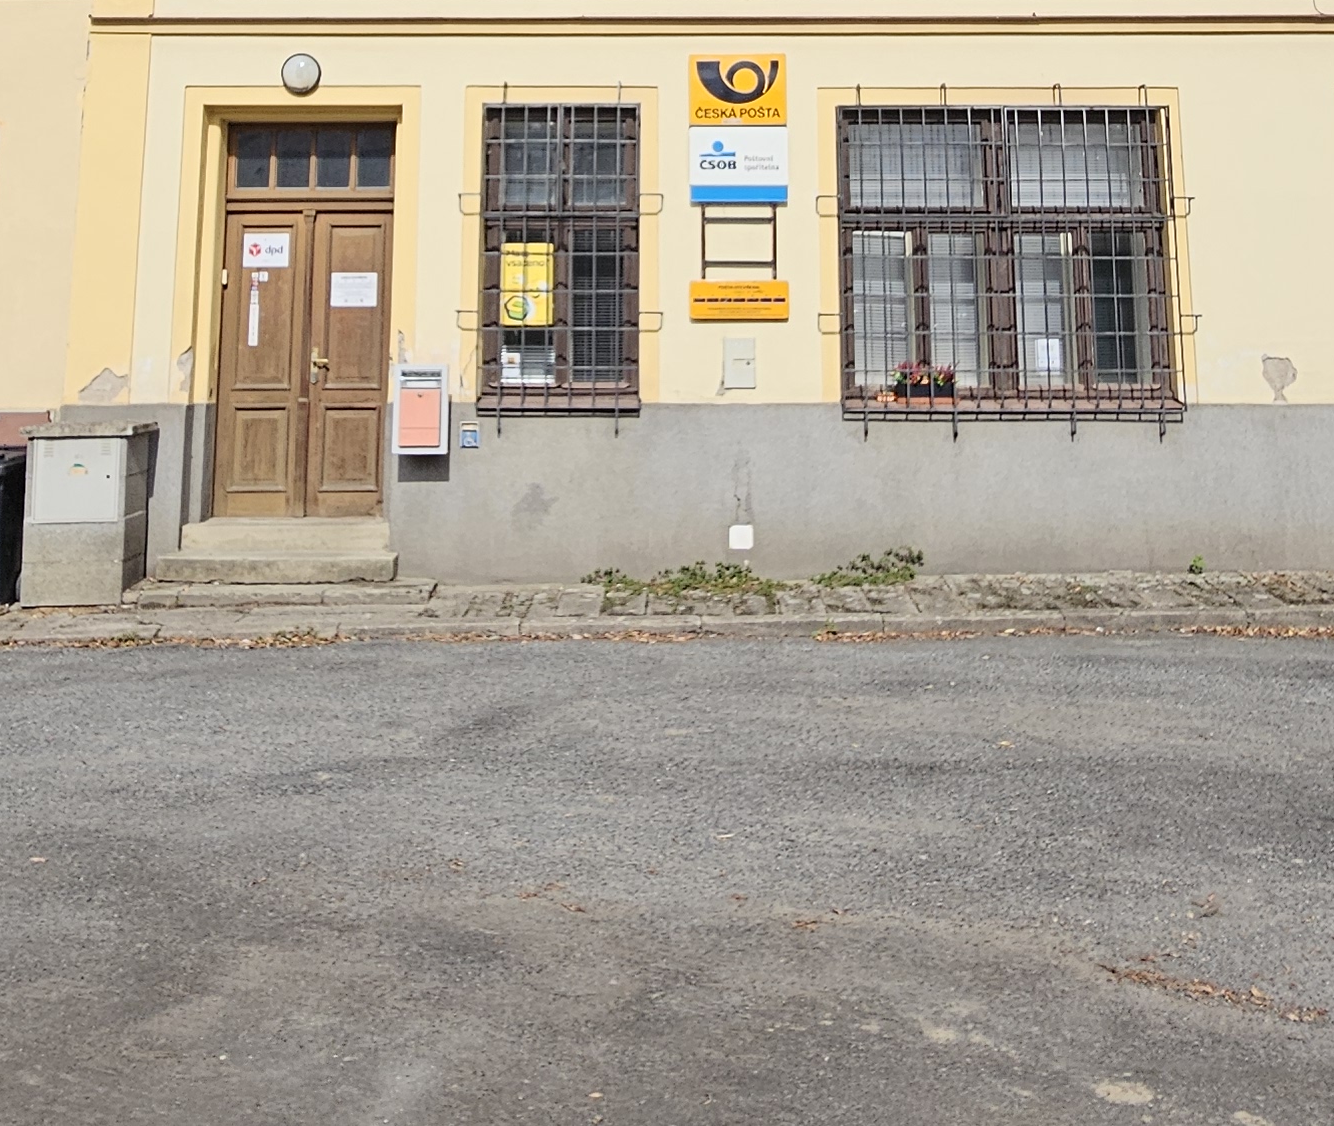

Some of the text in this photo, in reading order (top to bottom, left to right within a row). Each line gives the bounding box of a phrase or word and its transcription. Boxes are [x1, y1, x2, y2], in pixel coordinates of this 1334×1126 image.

[694, 106, 781, 119] ČESKÁ POŠTA
[265, 245, 283, 255] dpd
